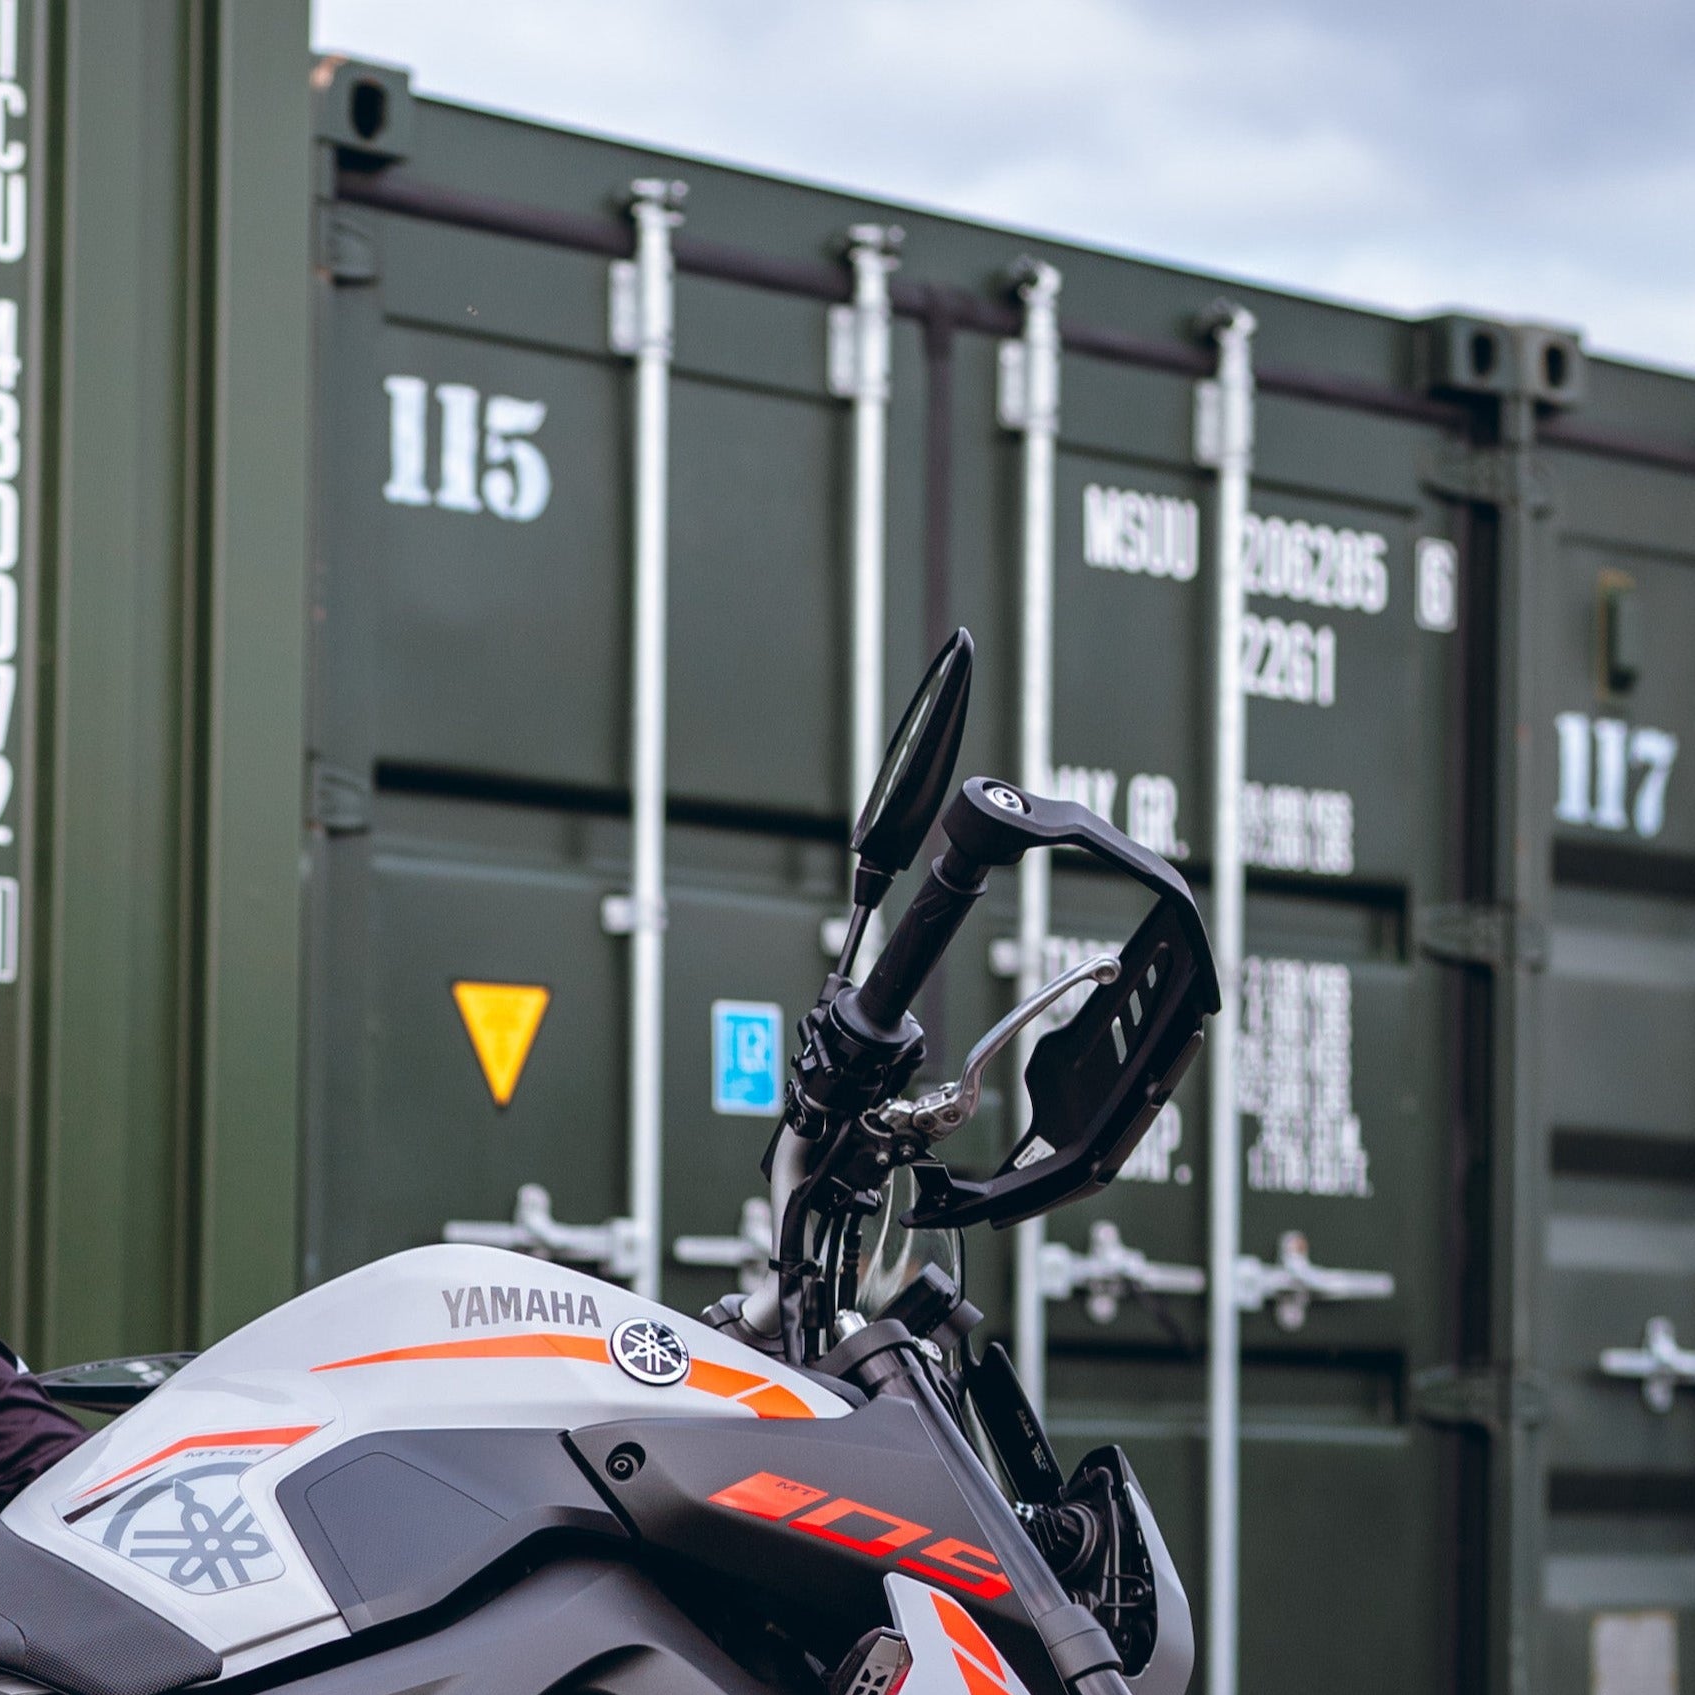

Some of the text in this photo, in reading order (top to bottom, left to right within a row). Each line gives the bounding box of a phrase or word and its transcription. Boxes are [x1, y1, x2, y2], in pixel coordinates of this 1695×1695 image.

[382, 374, 553, 522] 115
[1083, 483, 1200, 582] MSUU
[1554, 711, 1679, 838] 117
[441, 1285, 603, 1330] YAMAHA
